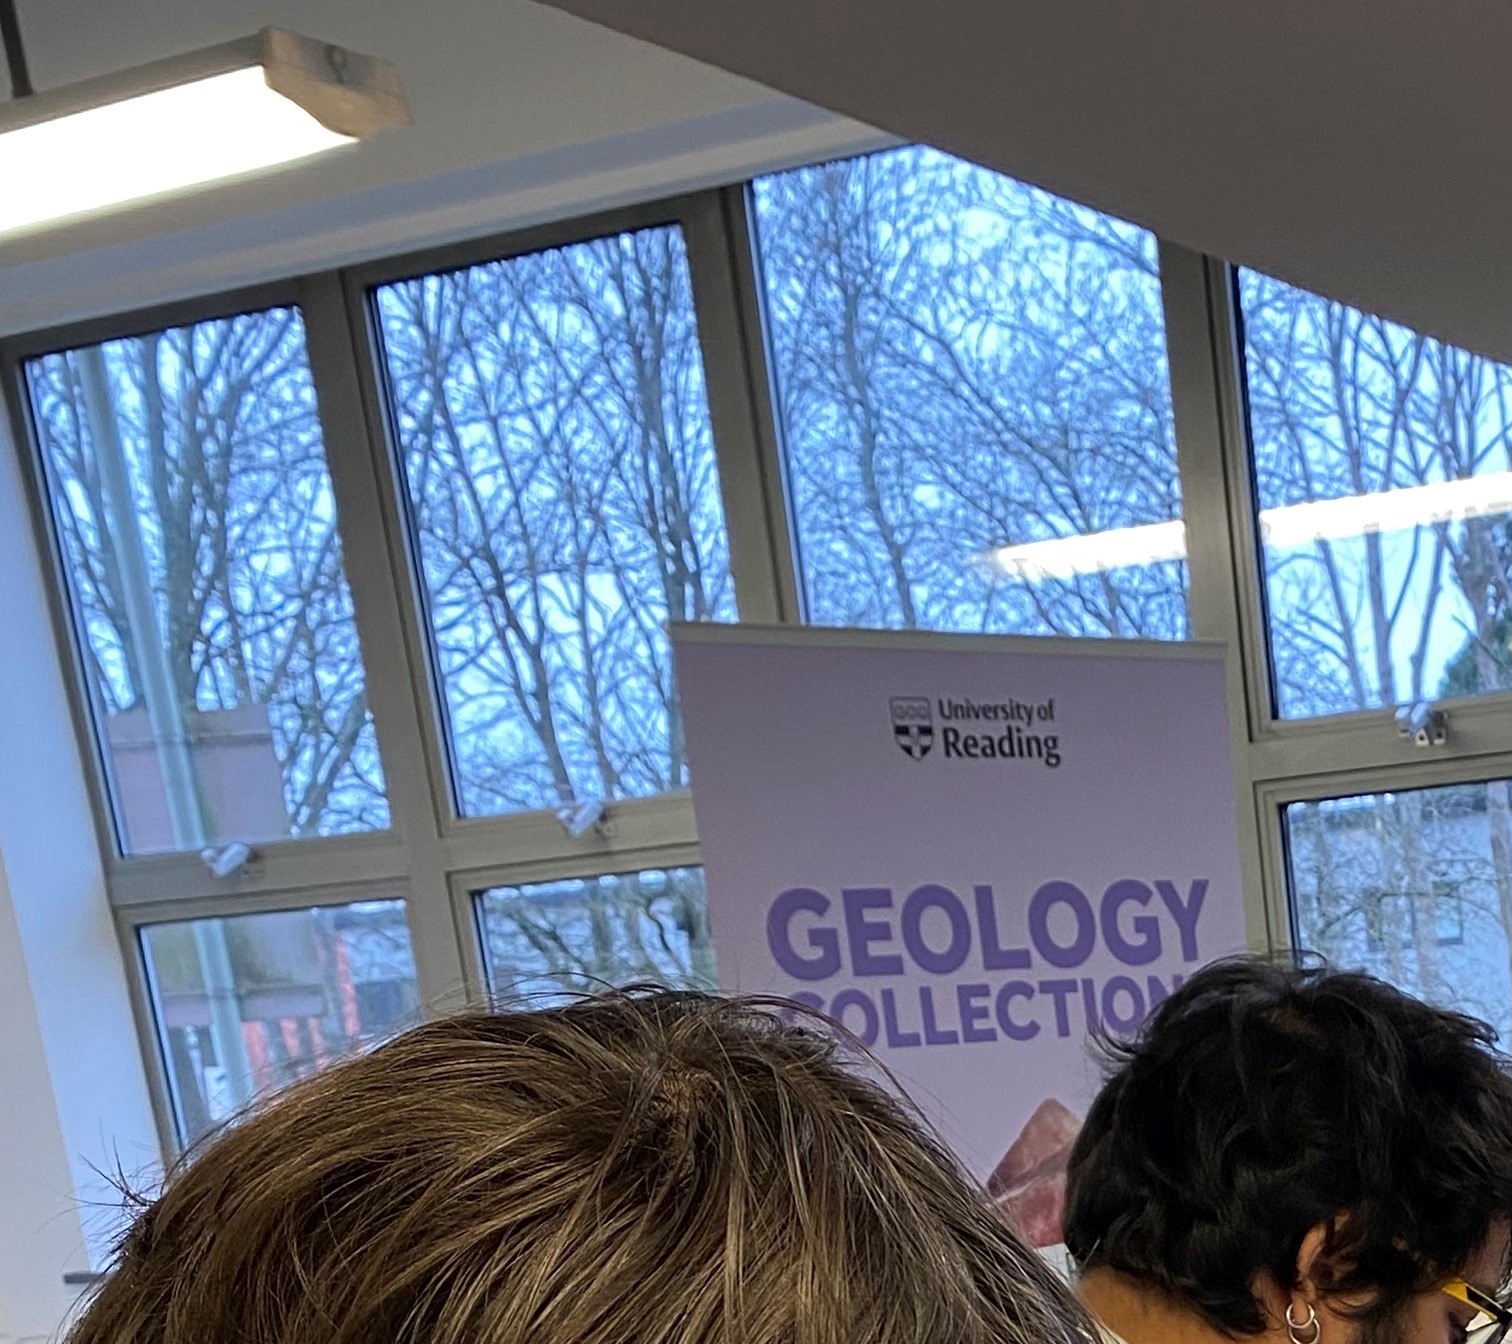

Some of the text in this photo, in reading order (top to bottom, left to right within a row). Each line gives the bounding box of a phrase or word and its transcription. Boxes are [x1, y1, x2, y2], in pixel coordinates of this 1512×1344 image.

[939, 697, 1057, 725] University of
[942, 726, 1063, 768] Reading
[766, 877, 1210, 982] GEOLOGY
